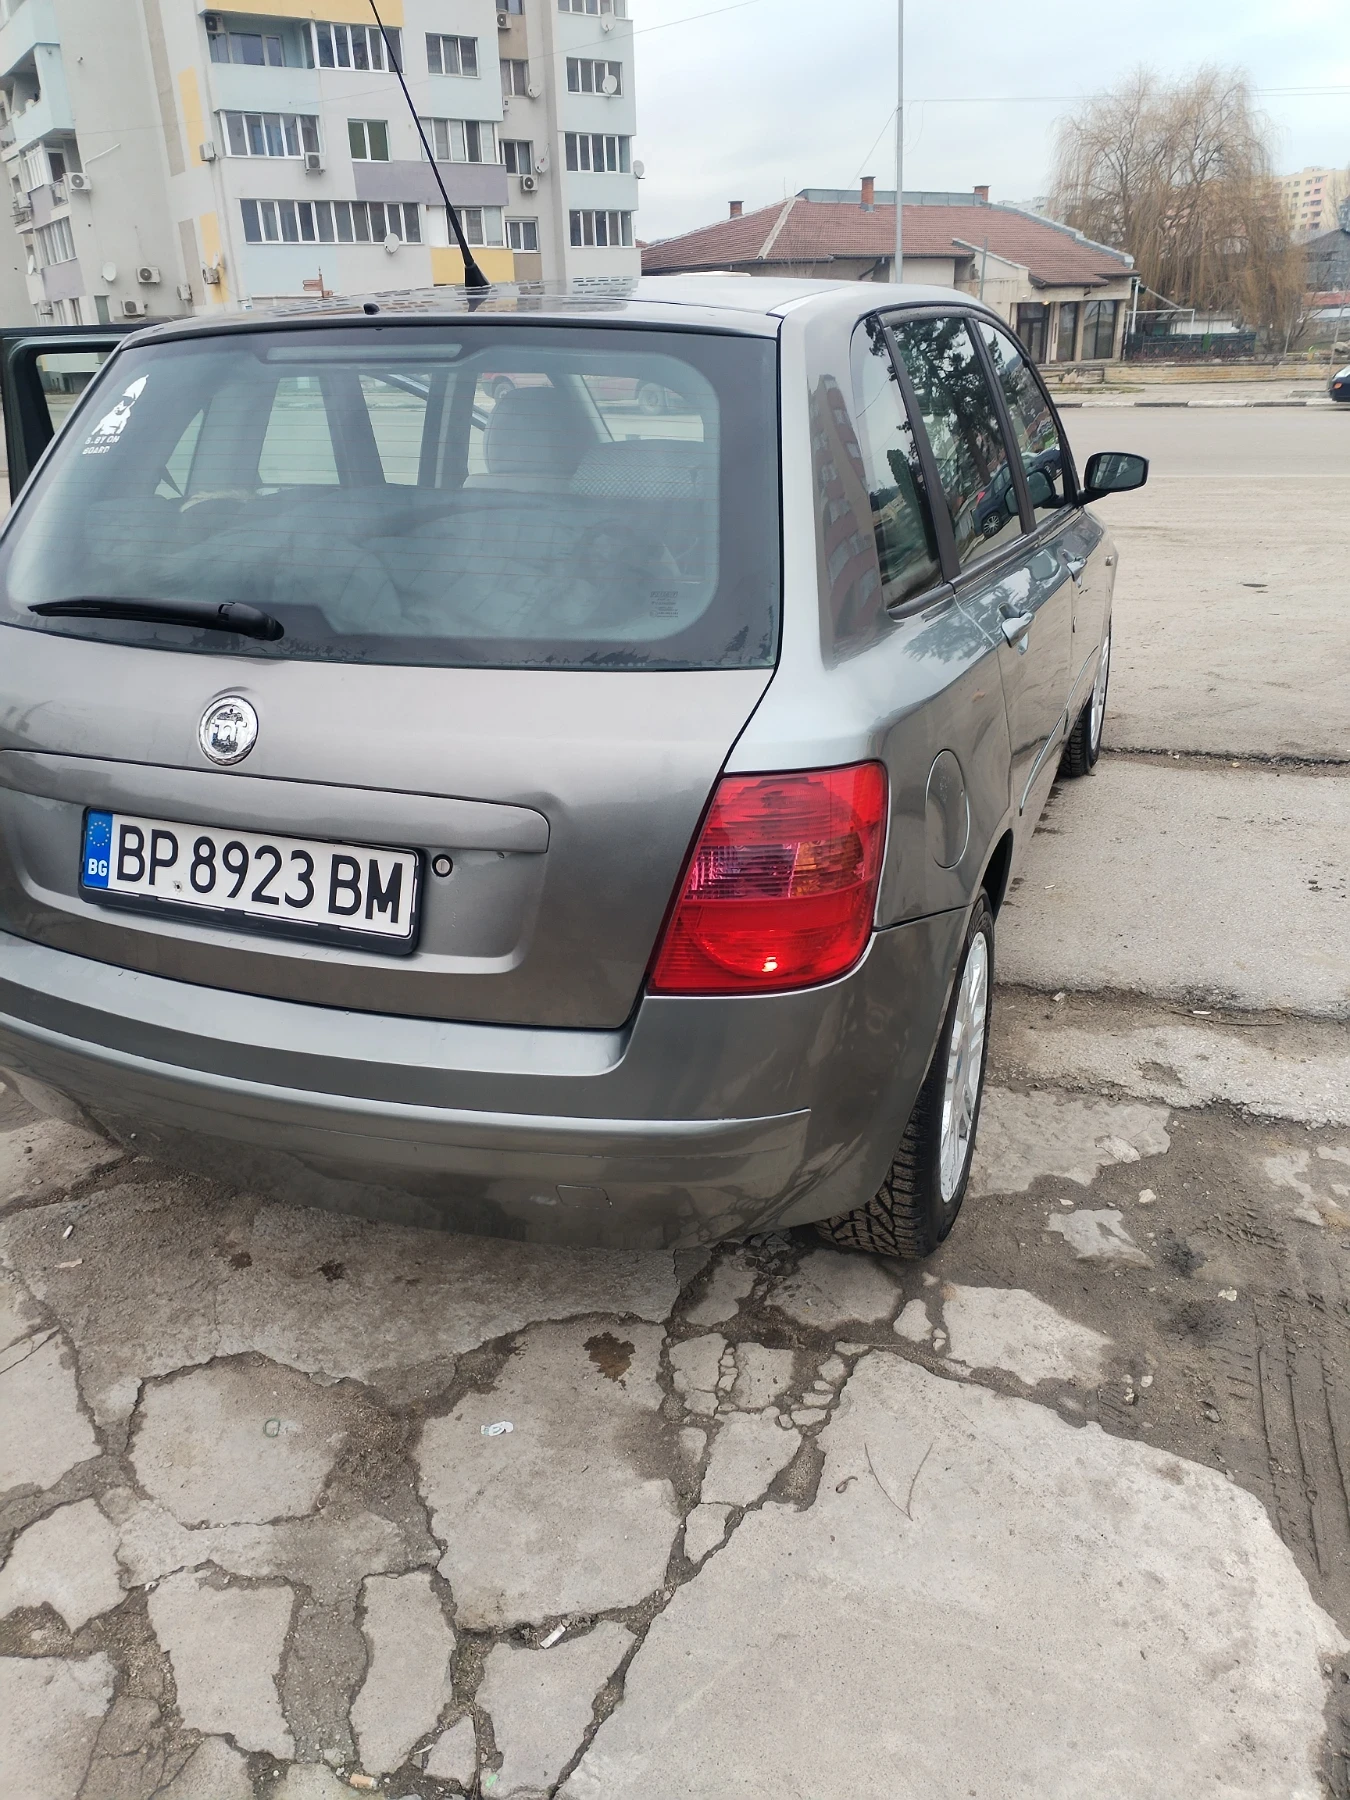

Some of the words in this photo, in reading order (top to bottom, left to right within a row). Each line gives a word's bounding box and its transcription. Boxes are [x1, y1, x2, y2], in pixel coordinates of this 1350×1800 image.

[84, 436, 107, 445] BBY
[106, 435, 121, 443] ON
[82, 445, 111, 455] BOARD
[88, 858, 108, 877] BG
[116, 823, 179, 886] BP
[189, 835, 315, 909] 8923
[327, 853, 403, 924] BM
